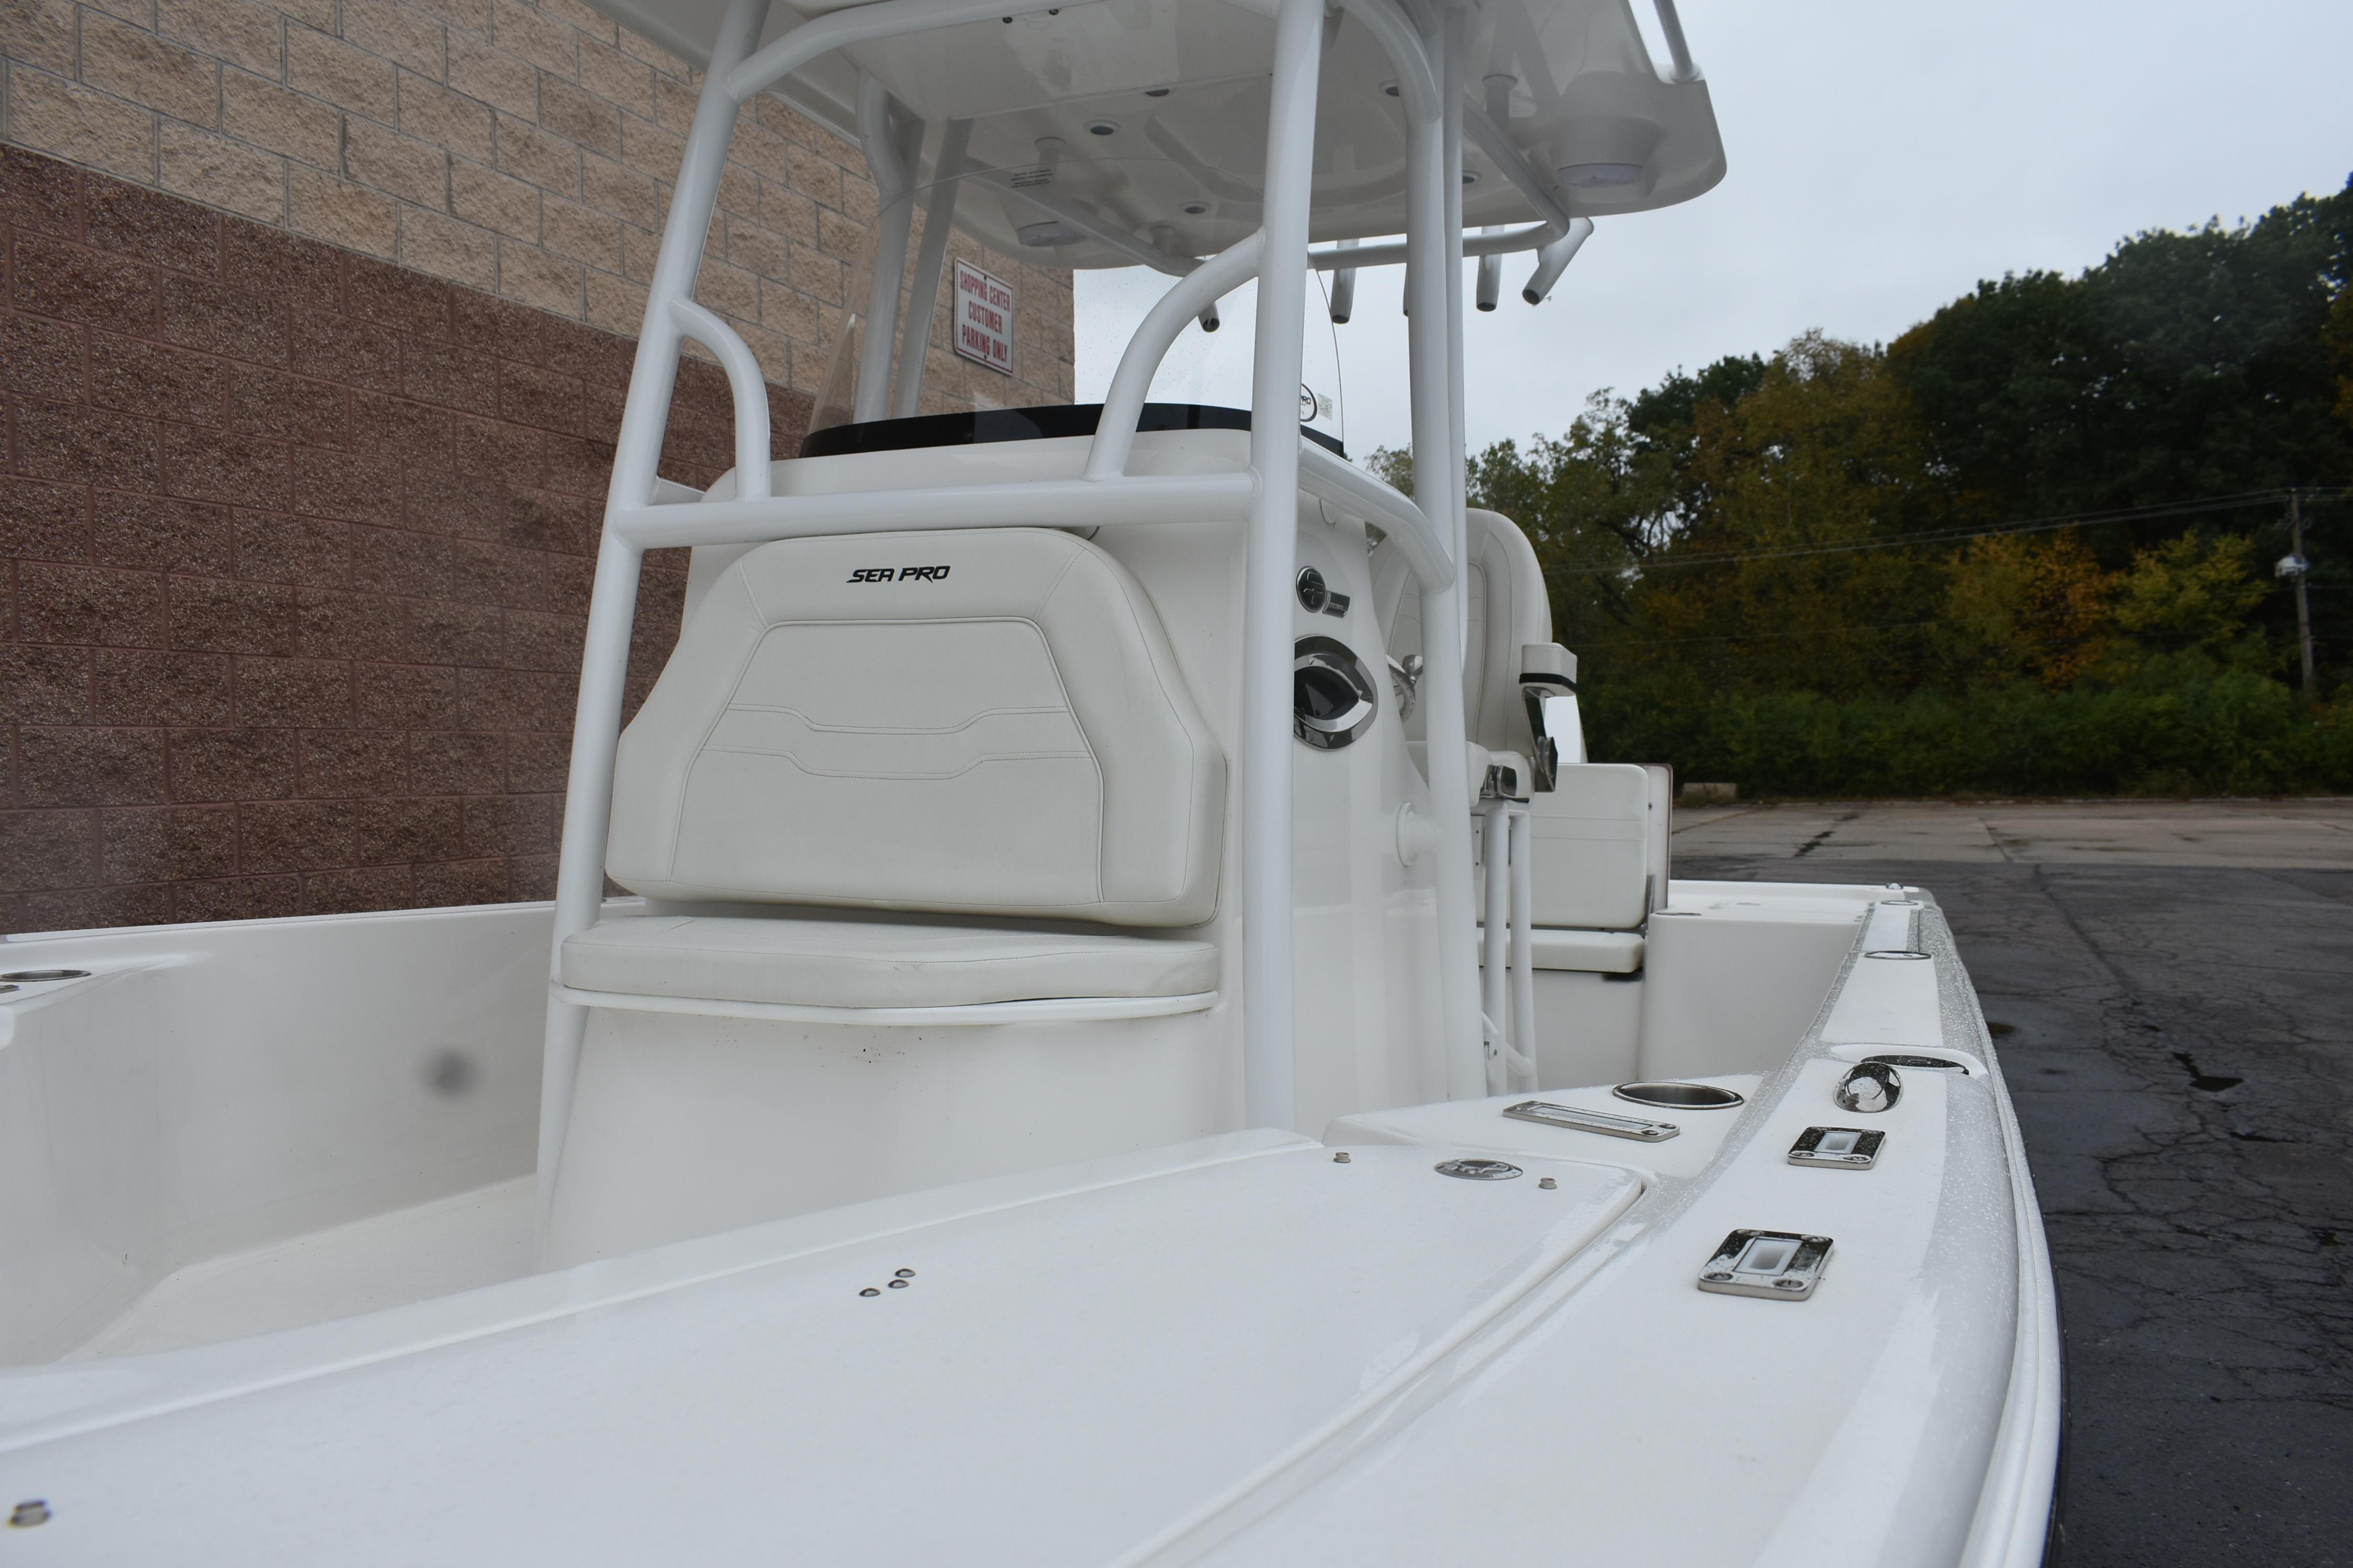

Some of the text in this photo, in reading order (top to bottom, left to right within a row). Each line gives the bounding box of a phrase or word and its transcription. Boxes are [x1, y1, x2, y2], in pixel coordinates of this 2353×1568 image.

[960, 270, 1010, 312] SHOPPING CENTER
[968, 300, 1003, 335] CUSTOMER
[962, 324, 1008, 363] PARKING ONLY
[846, 566, 951, 583] SEA PRO
